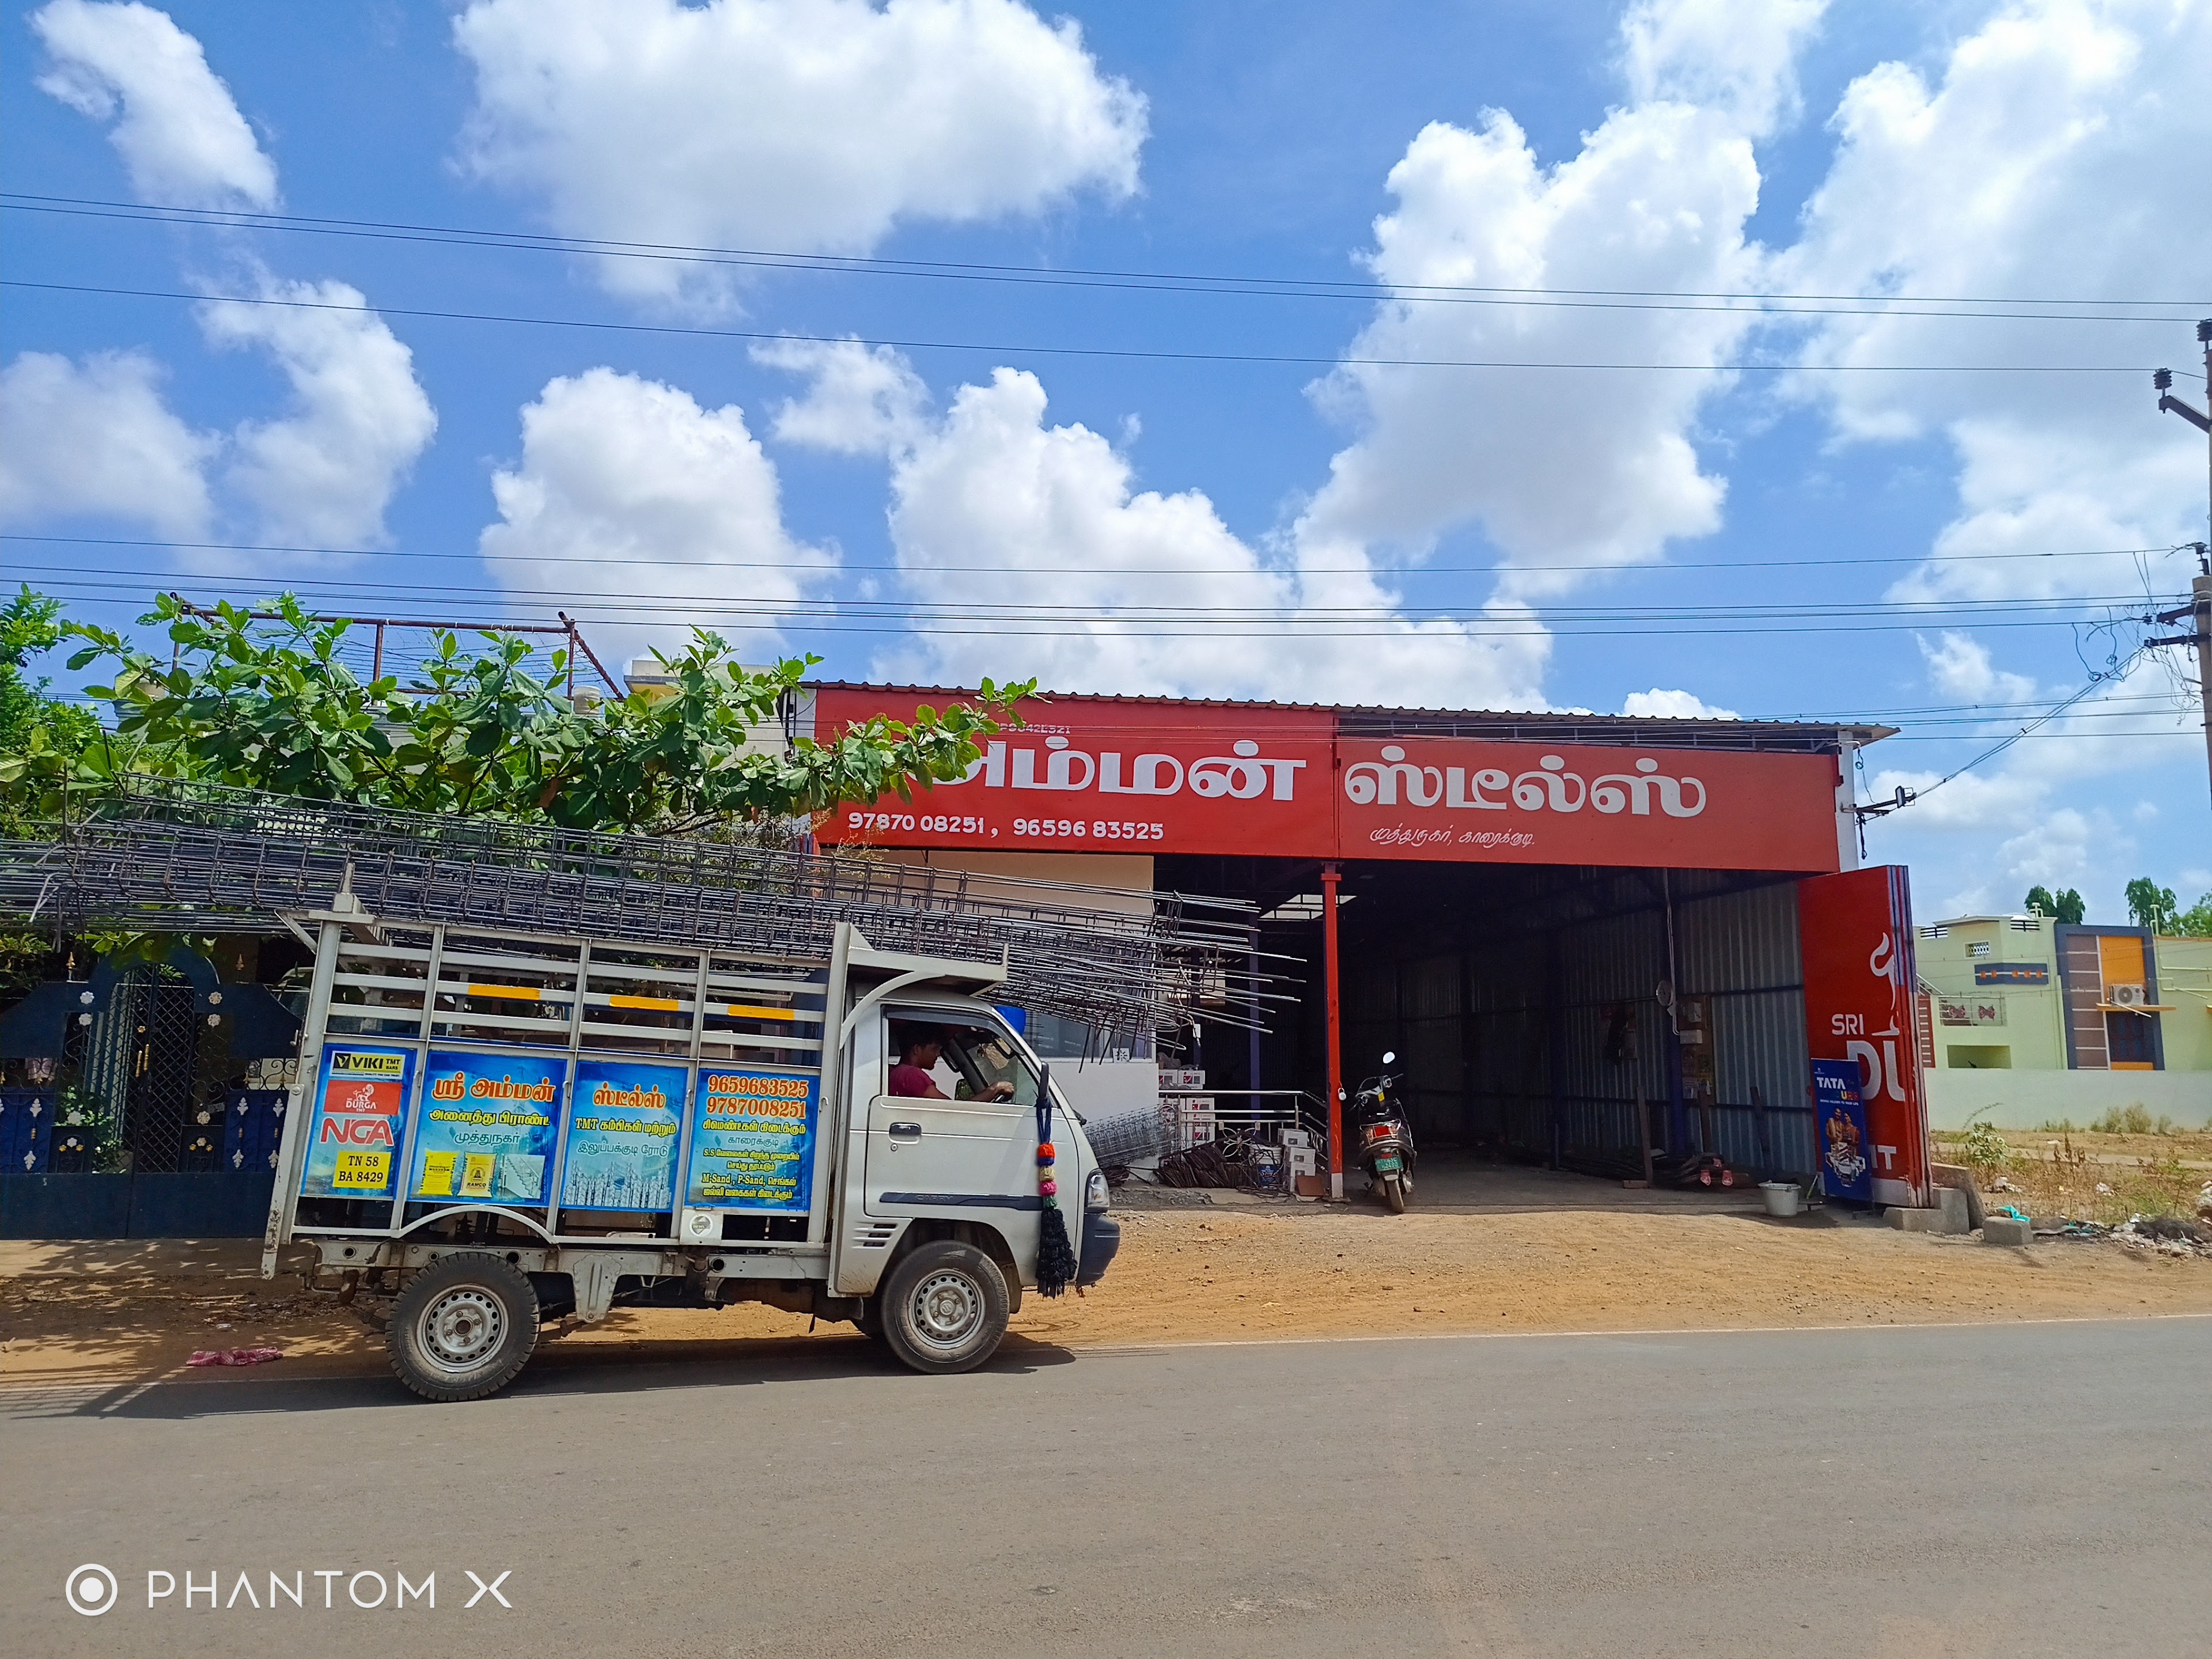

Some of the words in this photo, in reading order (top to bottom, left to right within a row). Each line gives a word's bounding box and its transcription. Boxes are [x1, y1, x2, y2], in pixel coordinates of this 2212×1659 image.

[1344, 745, 1706, 817] ஸ்டீல்ஸ்
[848, 812, 915, 831] 97870
[1013, 819, 1085, 836] 96596
[1092, 821, 1164, 840] 83525
[1832, 1014, 1864, 1035] SRI
[353, 1057, 383, 1069] VIKI
[471, 1075, 556, 1101] அம்மன்
[709, 1075, 809, 1098] 9659683525
[1816, 1077, 1846, 1089] TATA
[593, 1081, 666, 1108] ஸ்டீல்ஸ்
[346, 1100, 377, 1109] DURGA
[707, 1096, 806, 1119] 9787008251
[430, 1109, 495, 1126] அனைத்து
[320, 1117, 395, 1146] NGA
[575, 1117, 599, 1130] TMT
[600, 1119, 643, 1132] கம்பிகள்
[643, 1121, 677, 1137] மற்றும்
[759, 1121, 806, 1135] கிடைக்கும்
[454, 1130, 520, 1146] முத்துநகர்
[728, 1136, 779, 1147] காரைக்குடி
[578, 1140, 638, 1157] இலுப்பக்குடி
[641, 1145, 668, 1157] ரோடு
[348, 1156, 363, 1166] TN
[365, 1156, 379, 1166] 58
[338, 1171, 353, 1181] BA
[357, 1171, 383, 1182] 8429
